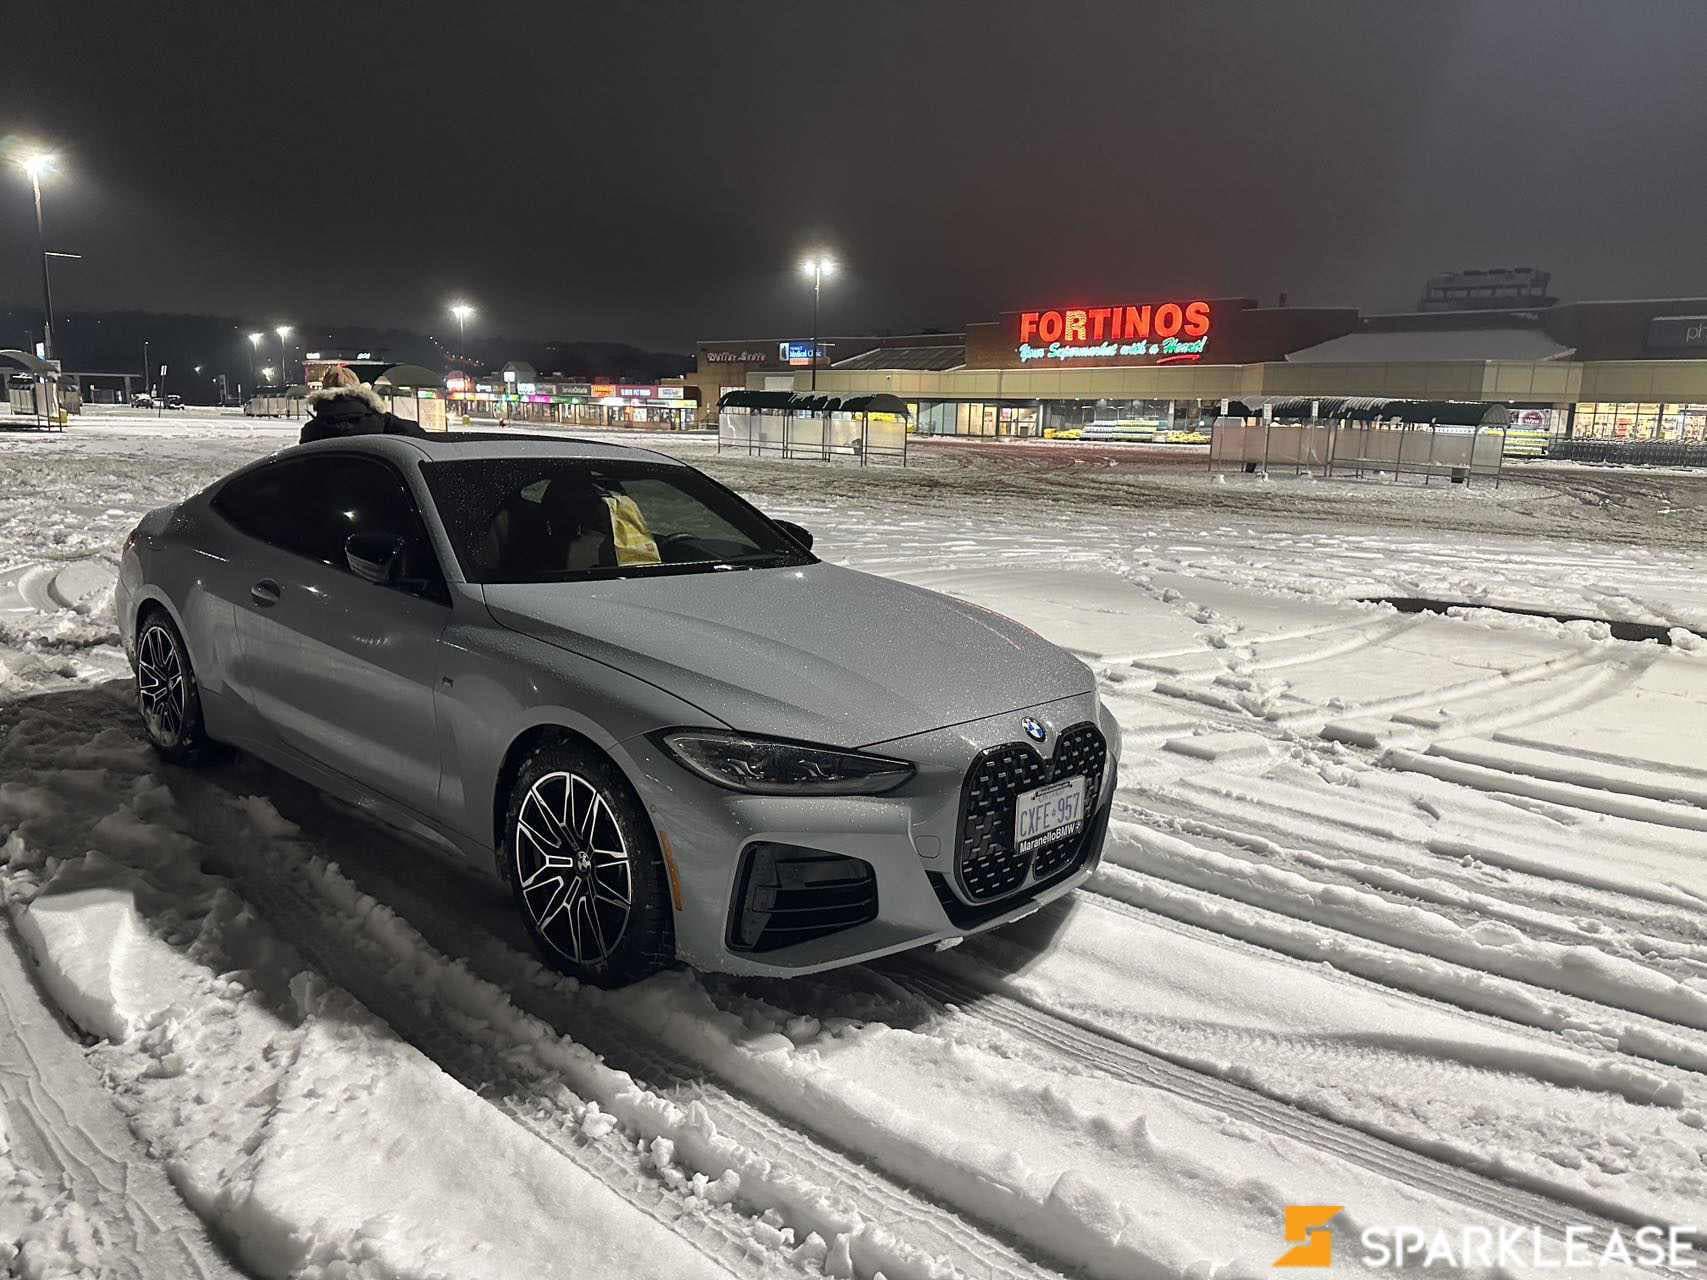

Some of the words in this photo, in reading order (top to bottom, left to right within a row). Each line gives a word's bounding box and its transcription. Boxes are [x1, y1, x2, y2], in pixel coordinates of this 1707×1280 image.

[1020, 301, 1210, 343] FORTINOS
[1018, 342, 1045, 362] Your
[1047, 341, 1118, 360] Supermarket
[1120, 340, 1146, 356] with
[1148, 344, 1160, 355] a
